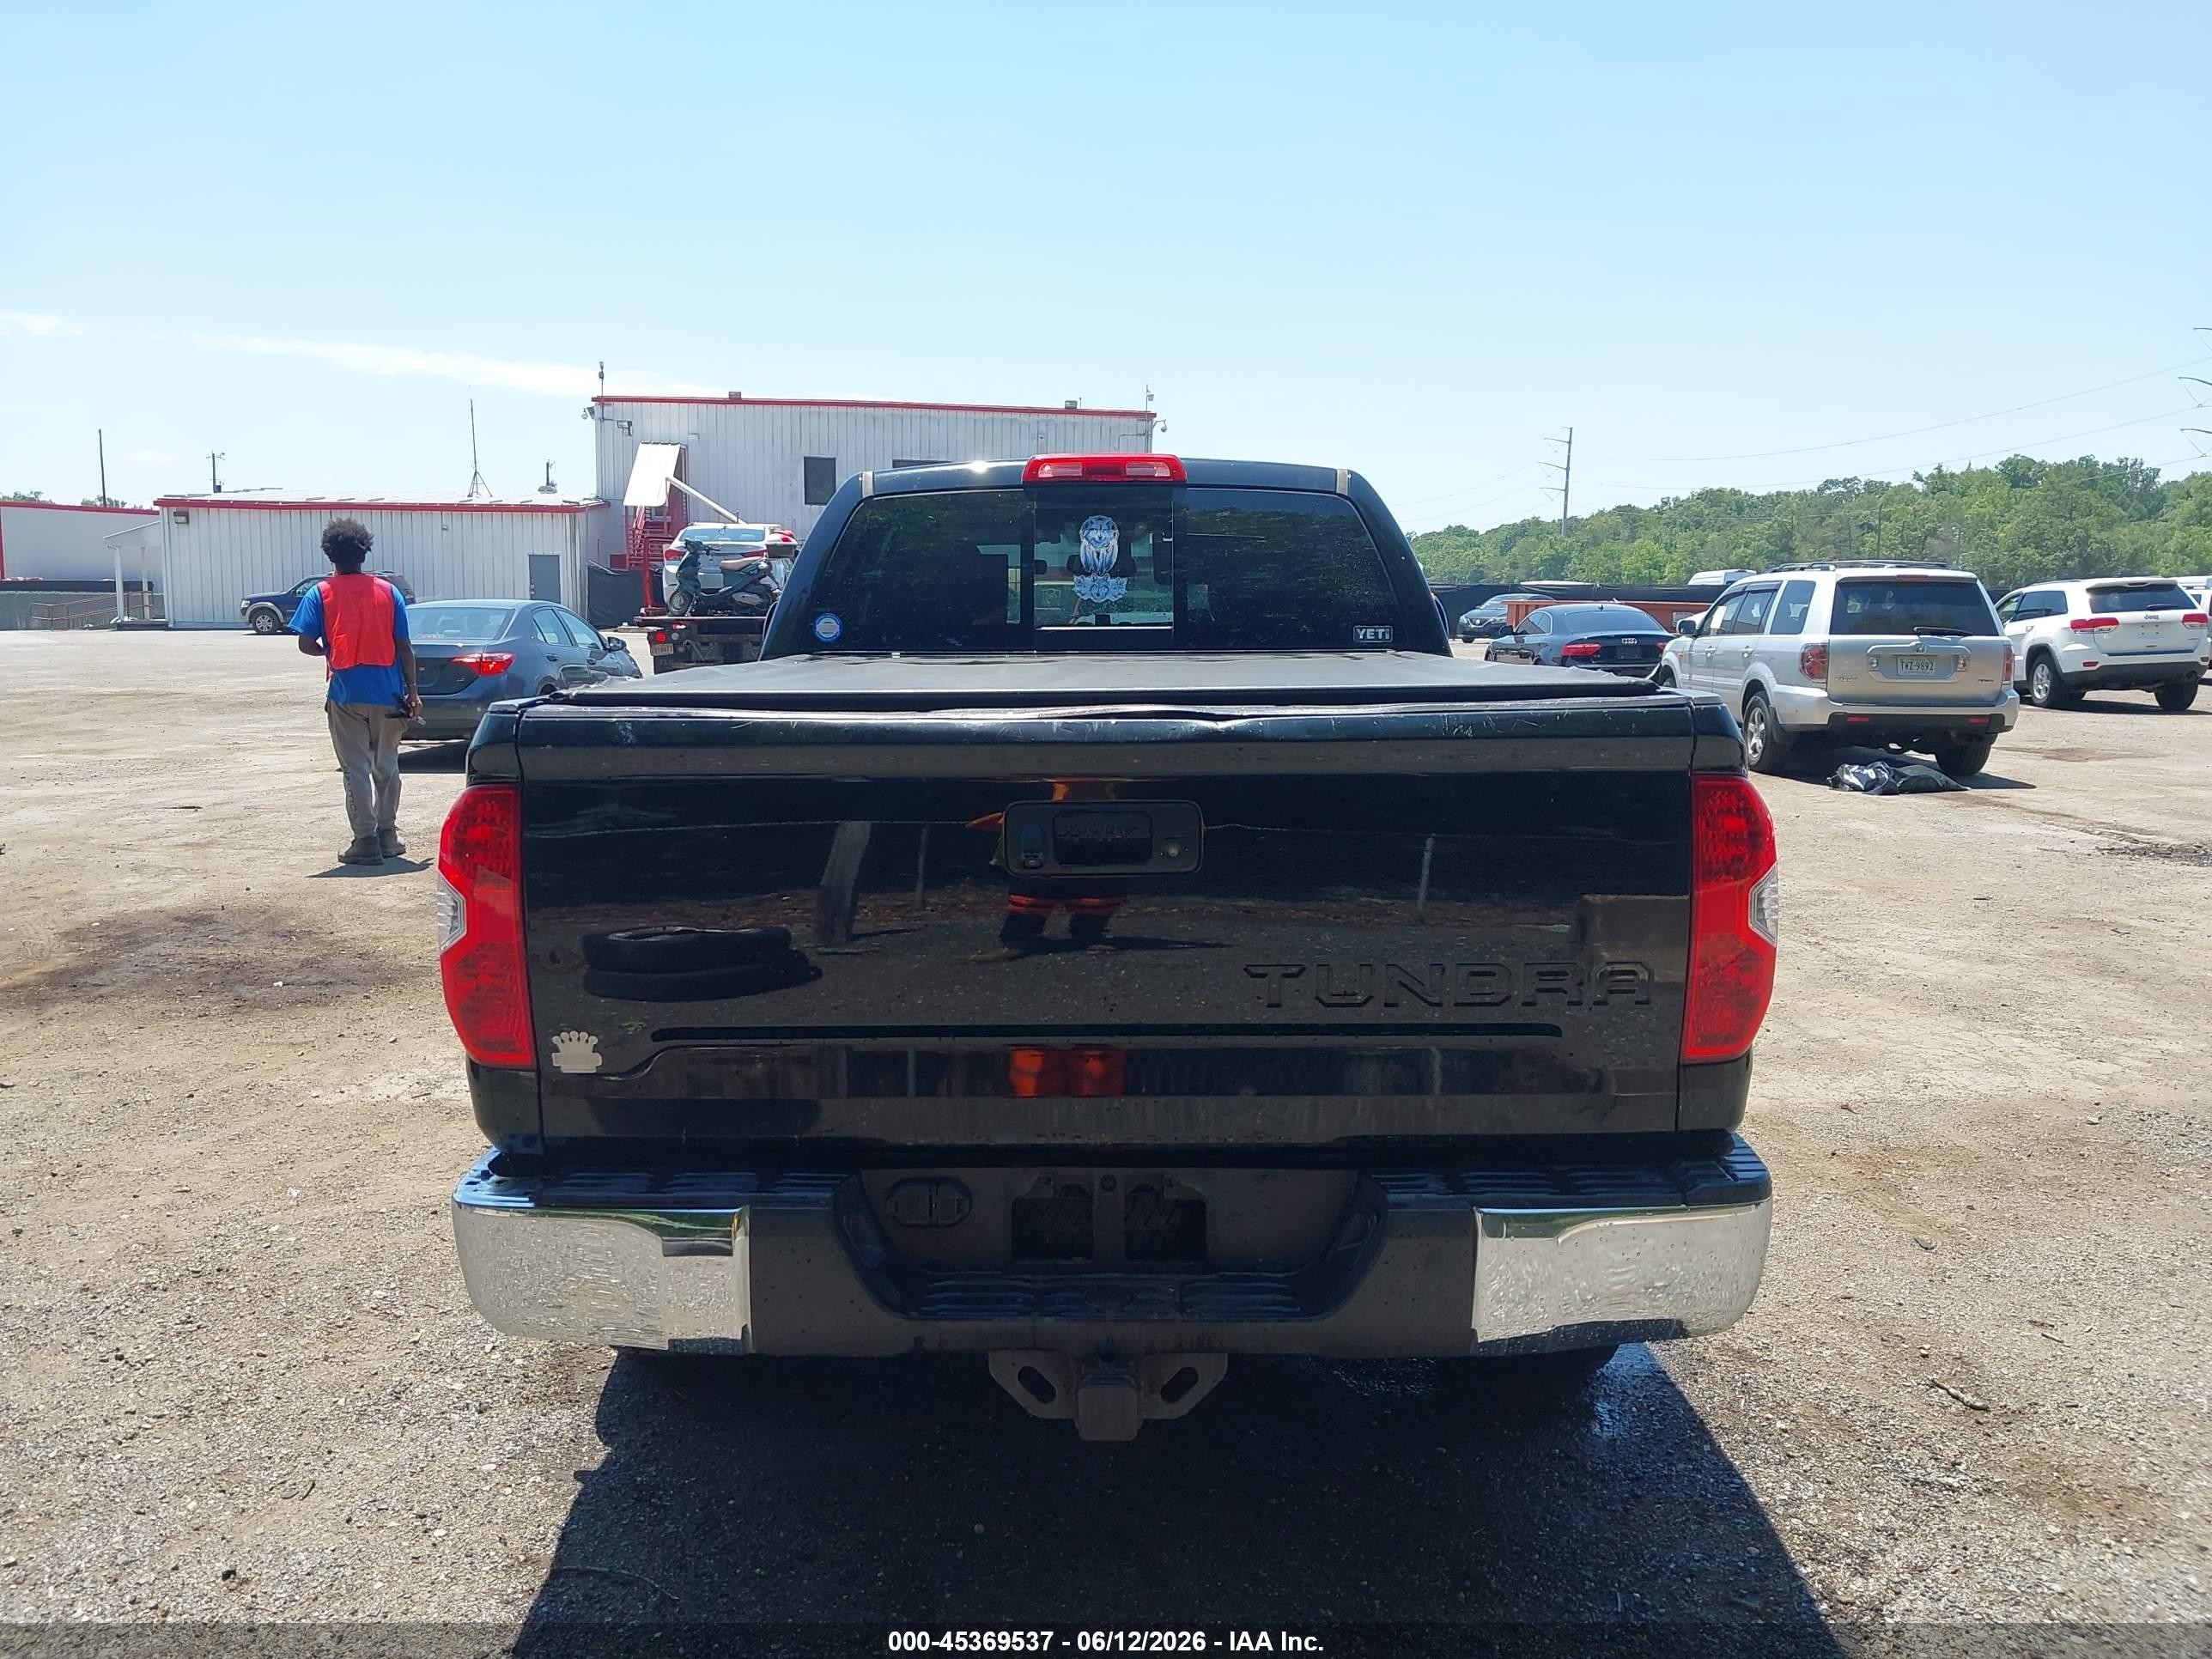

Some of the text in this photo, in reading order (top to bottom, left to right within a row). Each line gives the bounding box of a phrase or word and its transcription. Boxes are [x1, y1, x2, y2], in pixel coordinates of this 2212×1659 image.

[1356, 628, 1390, 640] YETI
[1899, 661, 1934, 672] TWZ-9892
[1243, 963, 1652, 1008] TUNDRA
